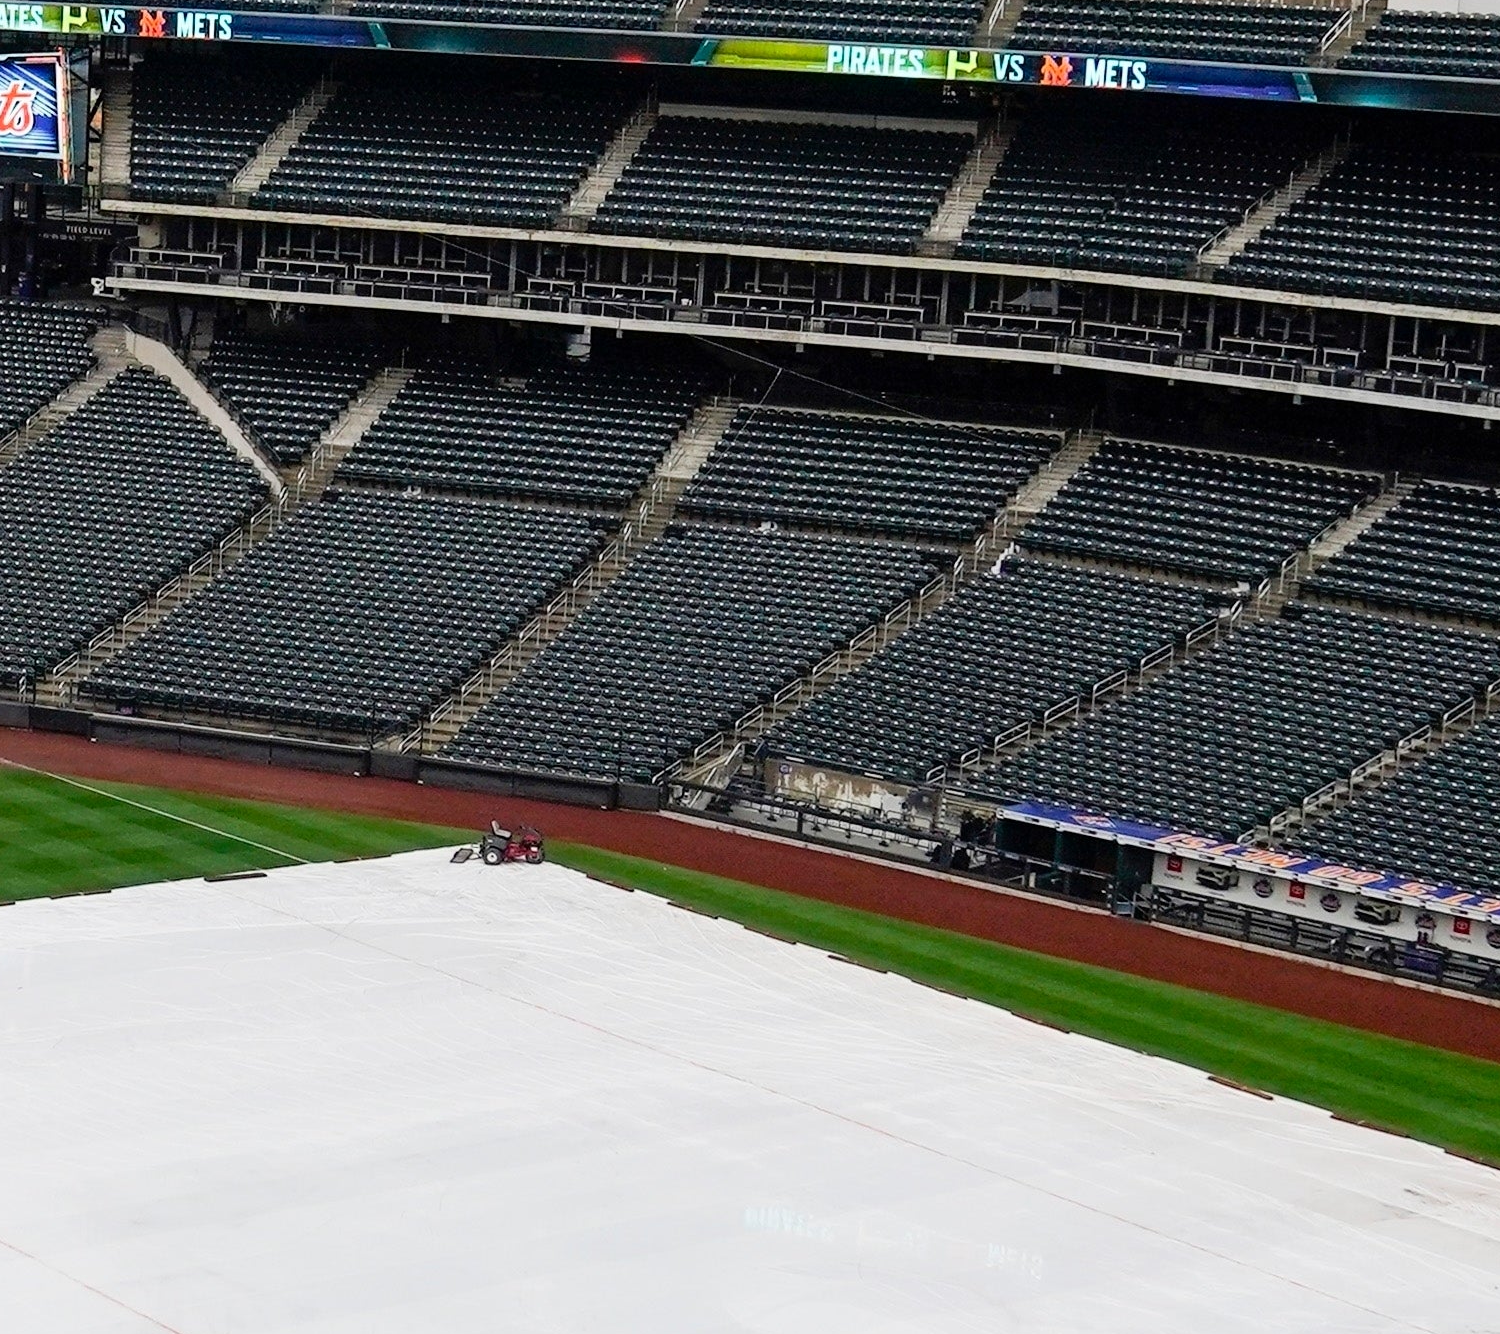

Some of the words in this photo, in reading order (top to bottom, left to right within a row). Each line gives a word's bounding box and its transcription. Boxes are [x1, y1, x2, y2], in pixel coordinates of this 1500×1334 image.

[100, 8, 126, 33] VS
[176, 11, 233, 41] METS
[827, 45, 925, 75] PIRATES
[994, 53, 1025, 82] VS
[1085, 58, 1147, 90] METS
